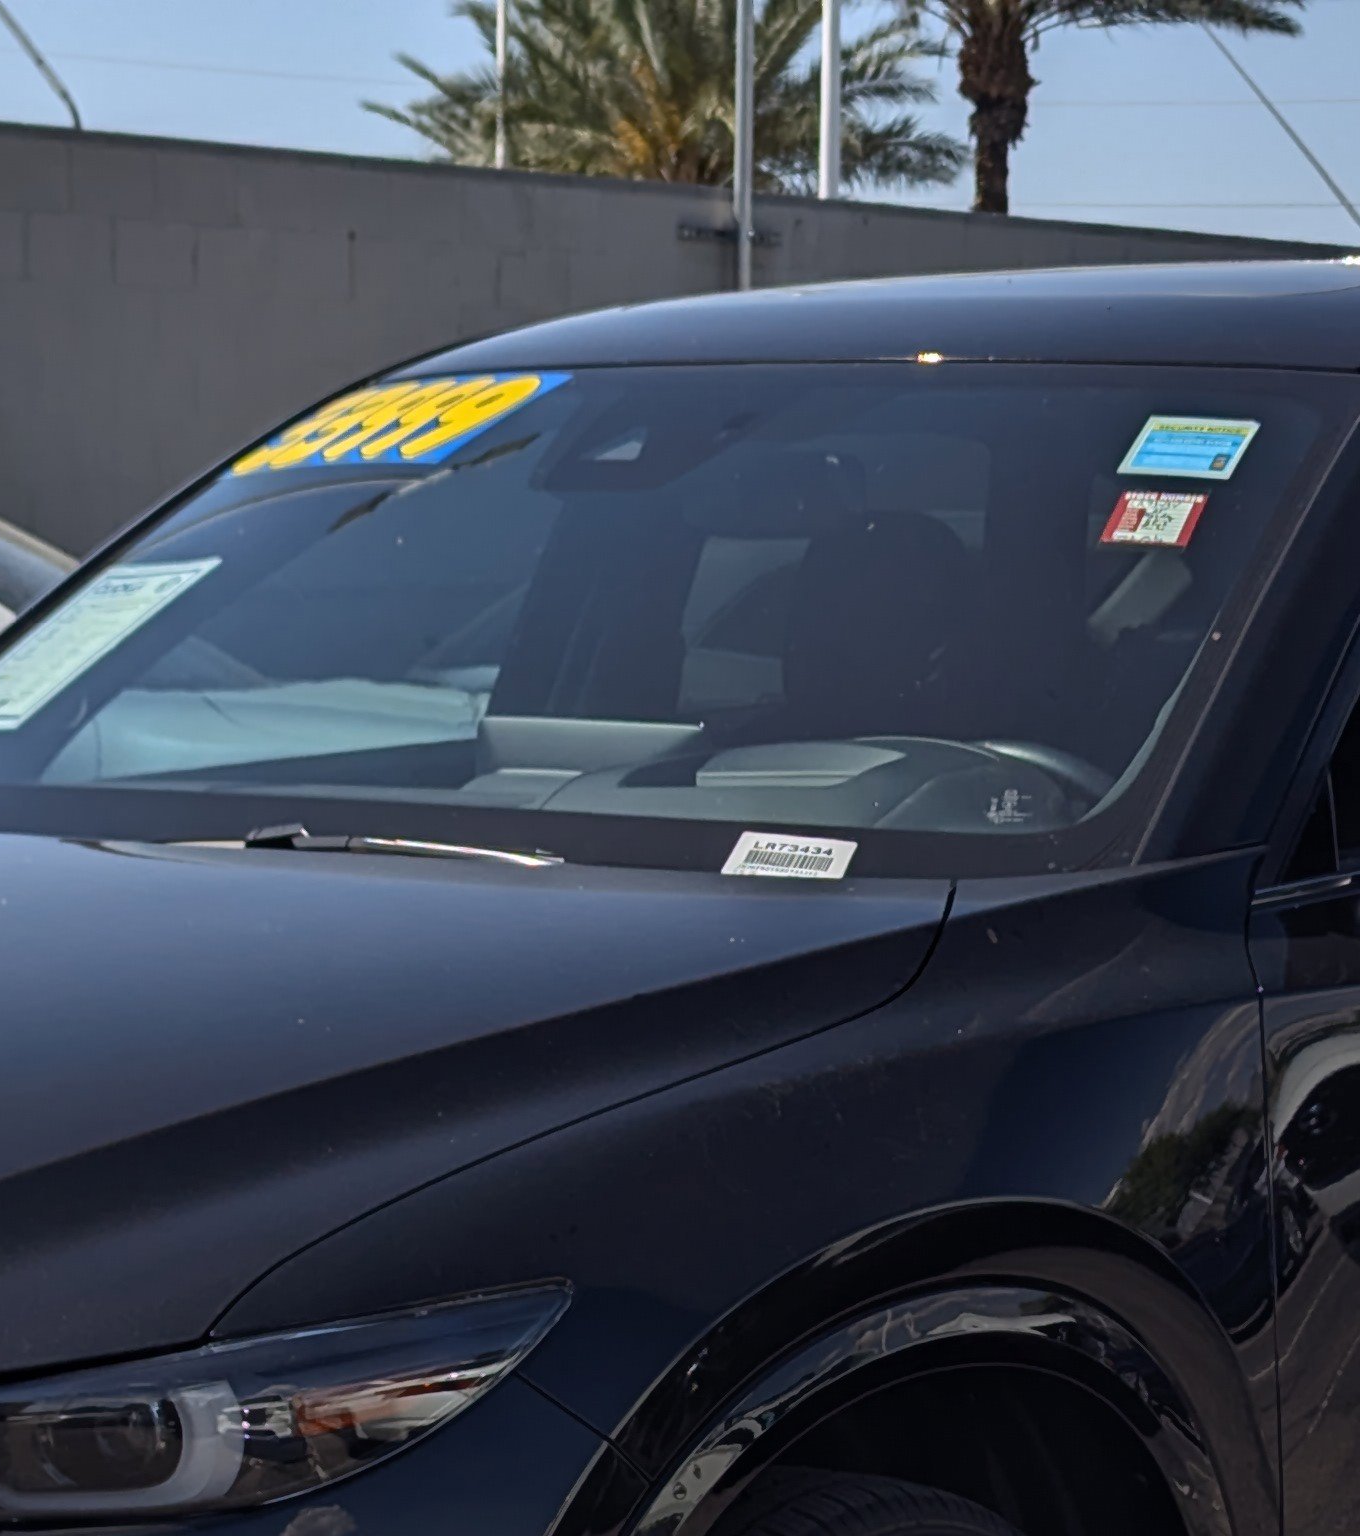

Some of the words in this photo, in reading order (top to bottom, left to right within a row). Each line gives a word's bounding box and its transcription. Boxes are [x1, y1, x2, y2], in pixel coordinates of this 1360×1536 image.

[1124, 491, 1157, 501] STOCK
[1159, 493, 1205, 503] NUMBER
[753, 840, 833, 856] LR73434
